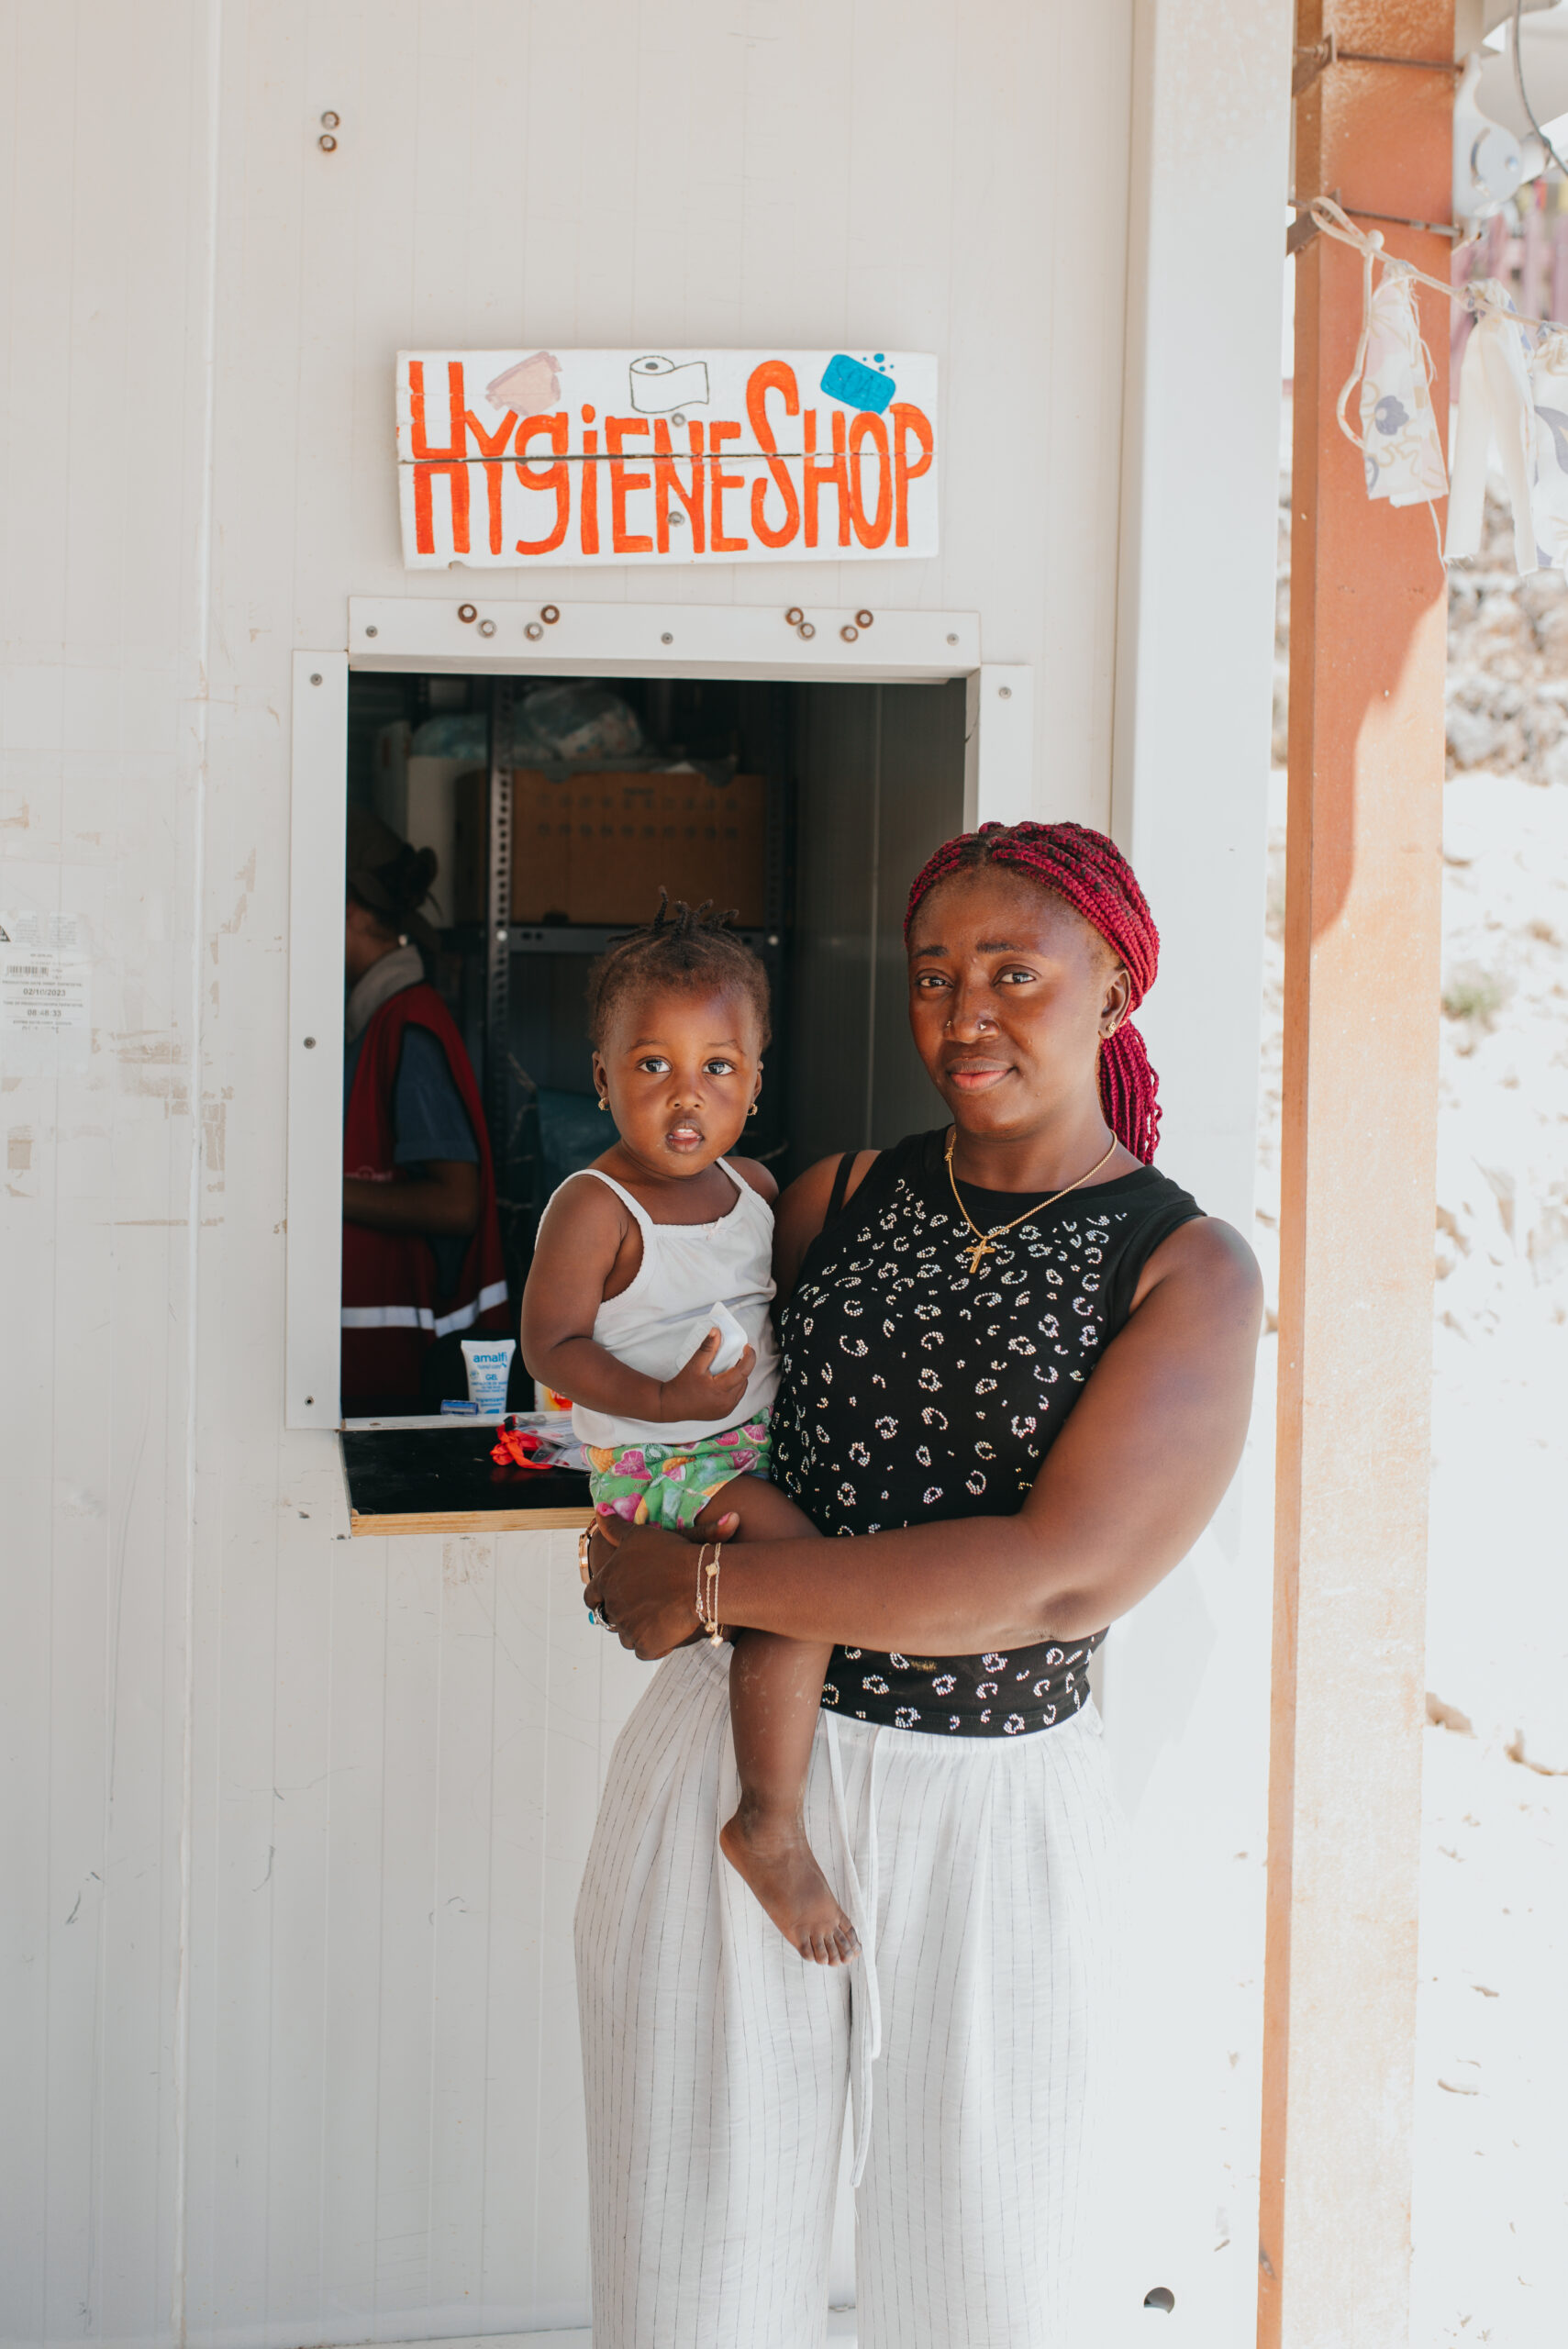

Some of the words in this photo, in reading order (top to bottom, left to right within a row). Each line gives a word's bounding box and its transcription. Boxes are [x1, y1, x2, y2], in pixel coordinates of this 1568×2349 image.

[746, 360, 933, 549] SHOP
[473, 1352, 507, 1364] amalfi
[484, 1373, 498, 1381] GEL
